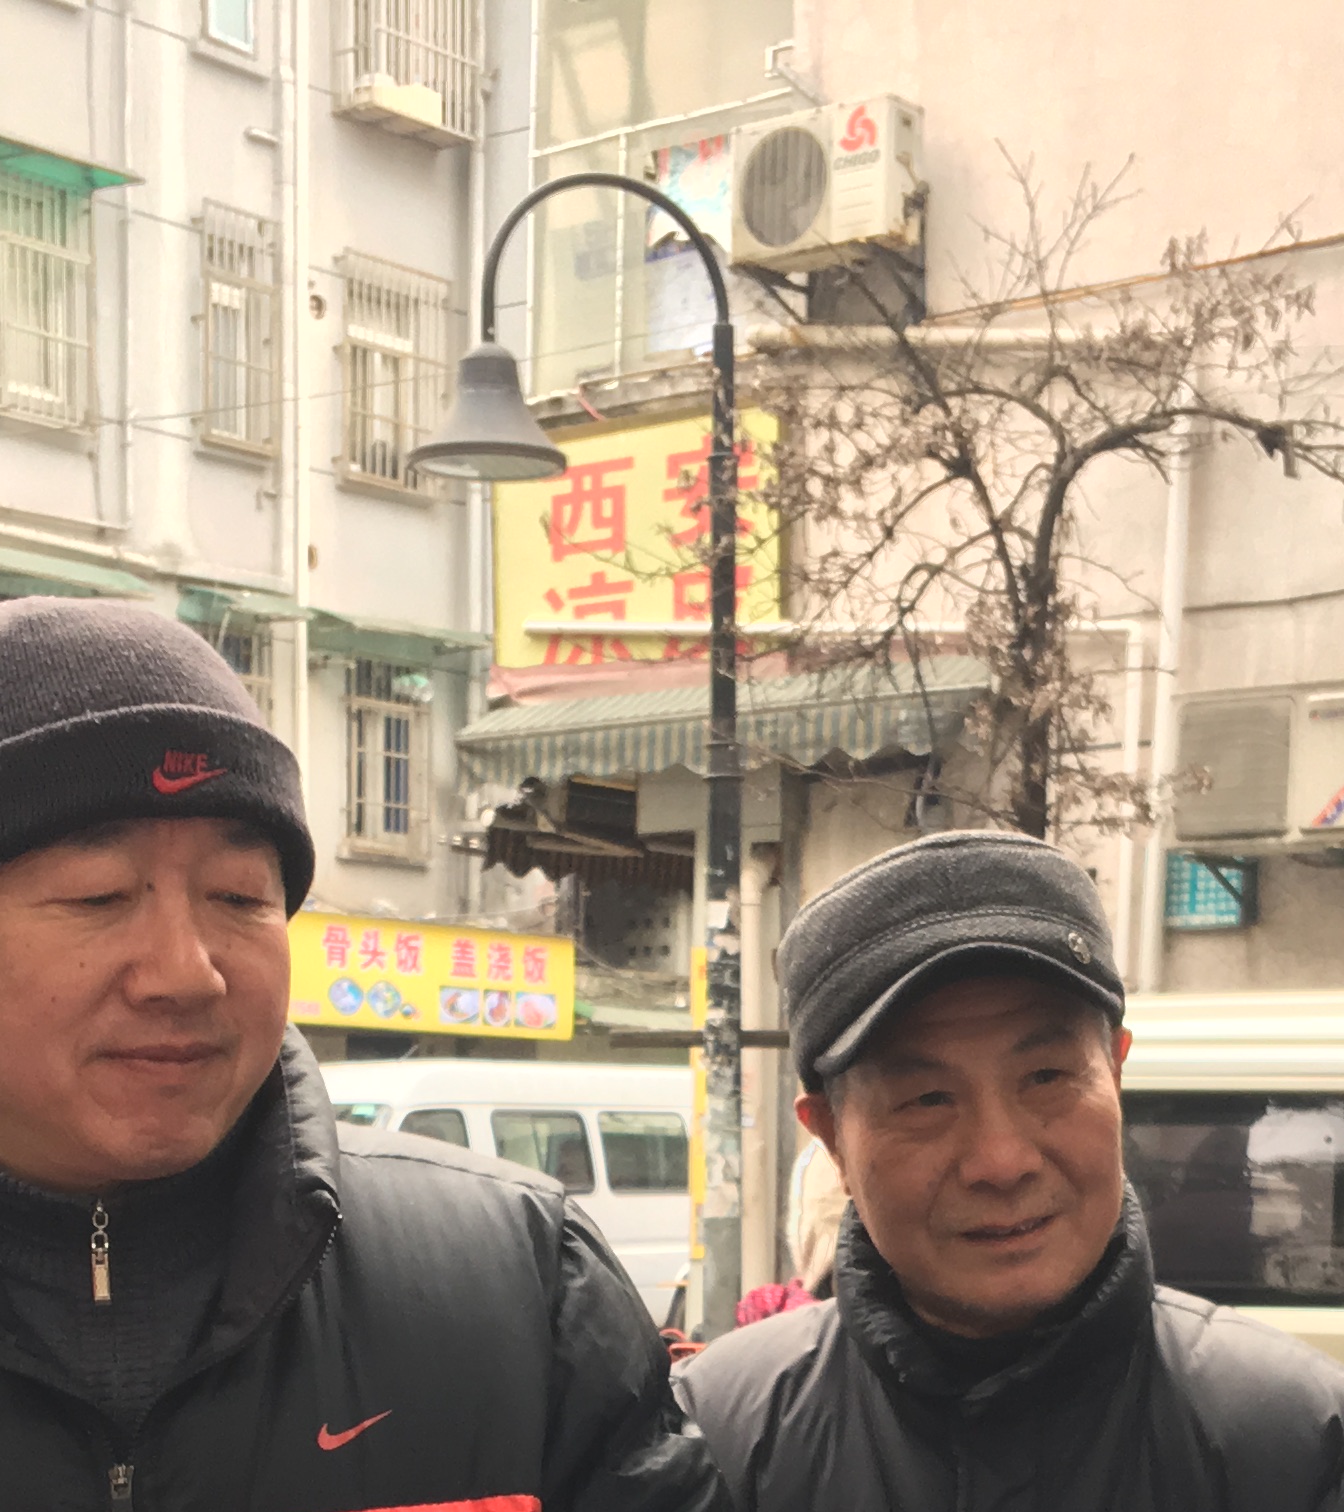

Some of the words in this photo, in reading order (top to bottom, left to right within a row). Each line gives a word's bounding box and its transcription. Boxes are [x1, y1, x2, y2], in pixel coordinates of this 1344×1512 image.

[162, 749, 209, 774] NIKE
[321, 923, 425, 975] 骨头饭
[450, 935, 550, 985] 盖浇饭
